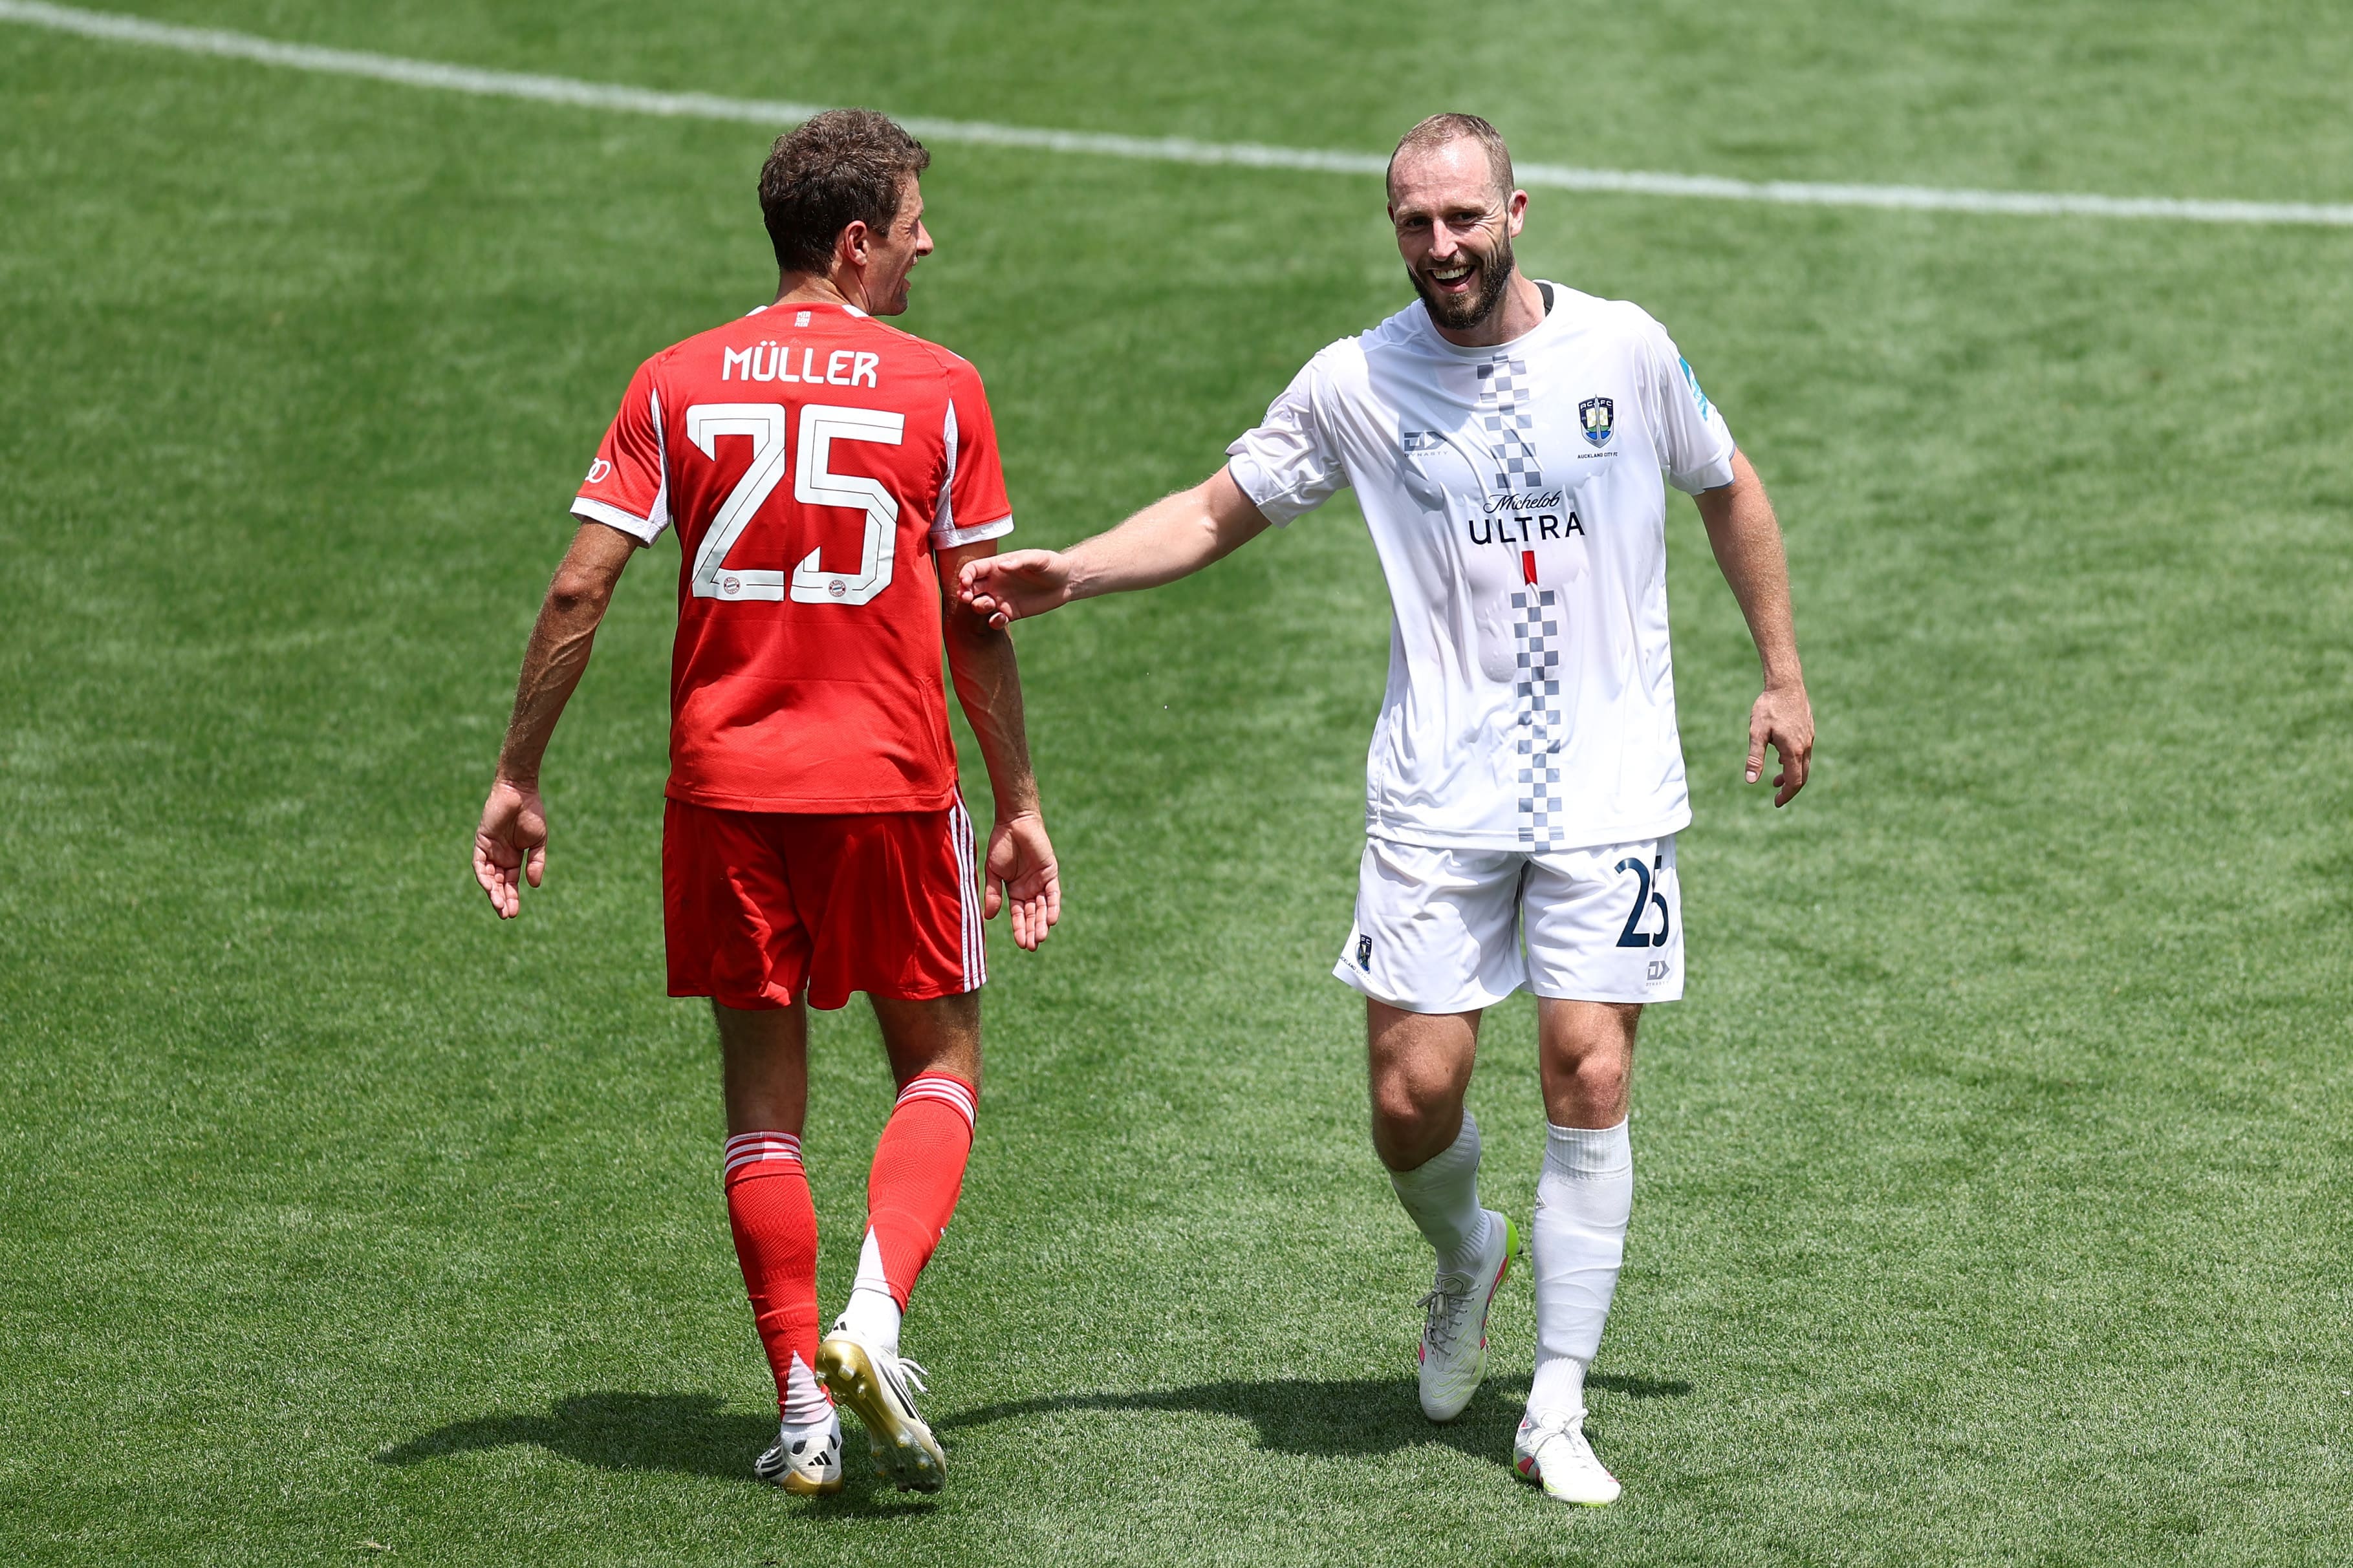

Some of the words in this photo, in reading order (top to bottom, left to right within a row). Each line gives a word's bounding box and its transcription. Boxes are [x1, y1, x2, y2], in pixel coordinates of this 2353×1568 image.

[722, 340, 879, 388] MÜLLER
[686, 403, 905, 605] 25
[1483, 490, 1562, 513] Michelob
[1469, 511, 1585, 545] ULTRA
